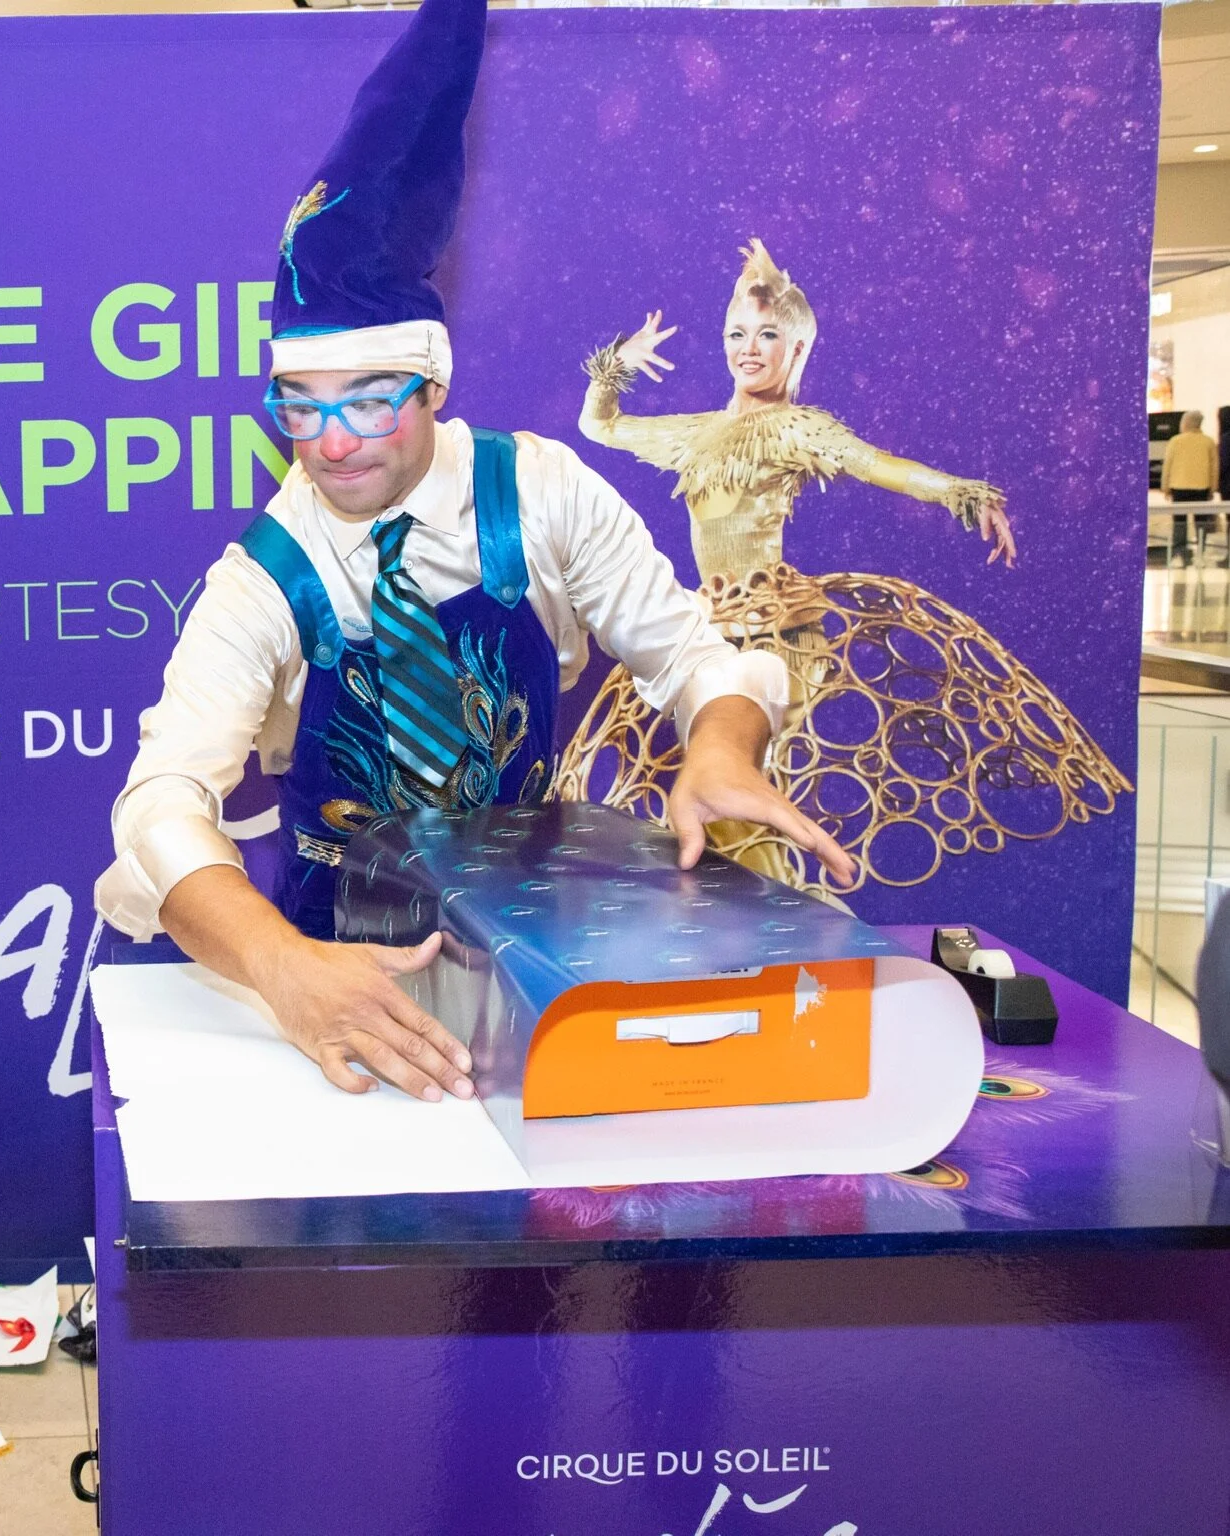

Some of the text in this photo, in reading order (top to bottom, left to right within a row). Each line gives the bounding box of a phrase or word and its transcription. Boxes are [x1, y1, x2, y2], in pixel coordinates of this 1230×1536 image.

[90, 281, 277, 381] GIF
[24, 708, 113, 760] DU
[516, 1452, 646, 1485] CIRQUE
[656, 1450, 703, 1476] DU
